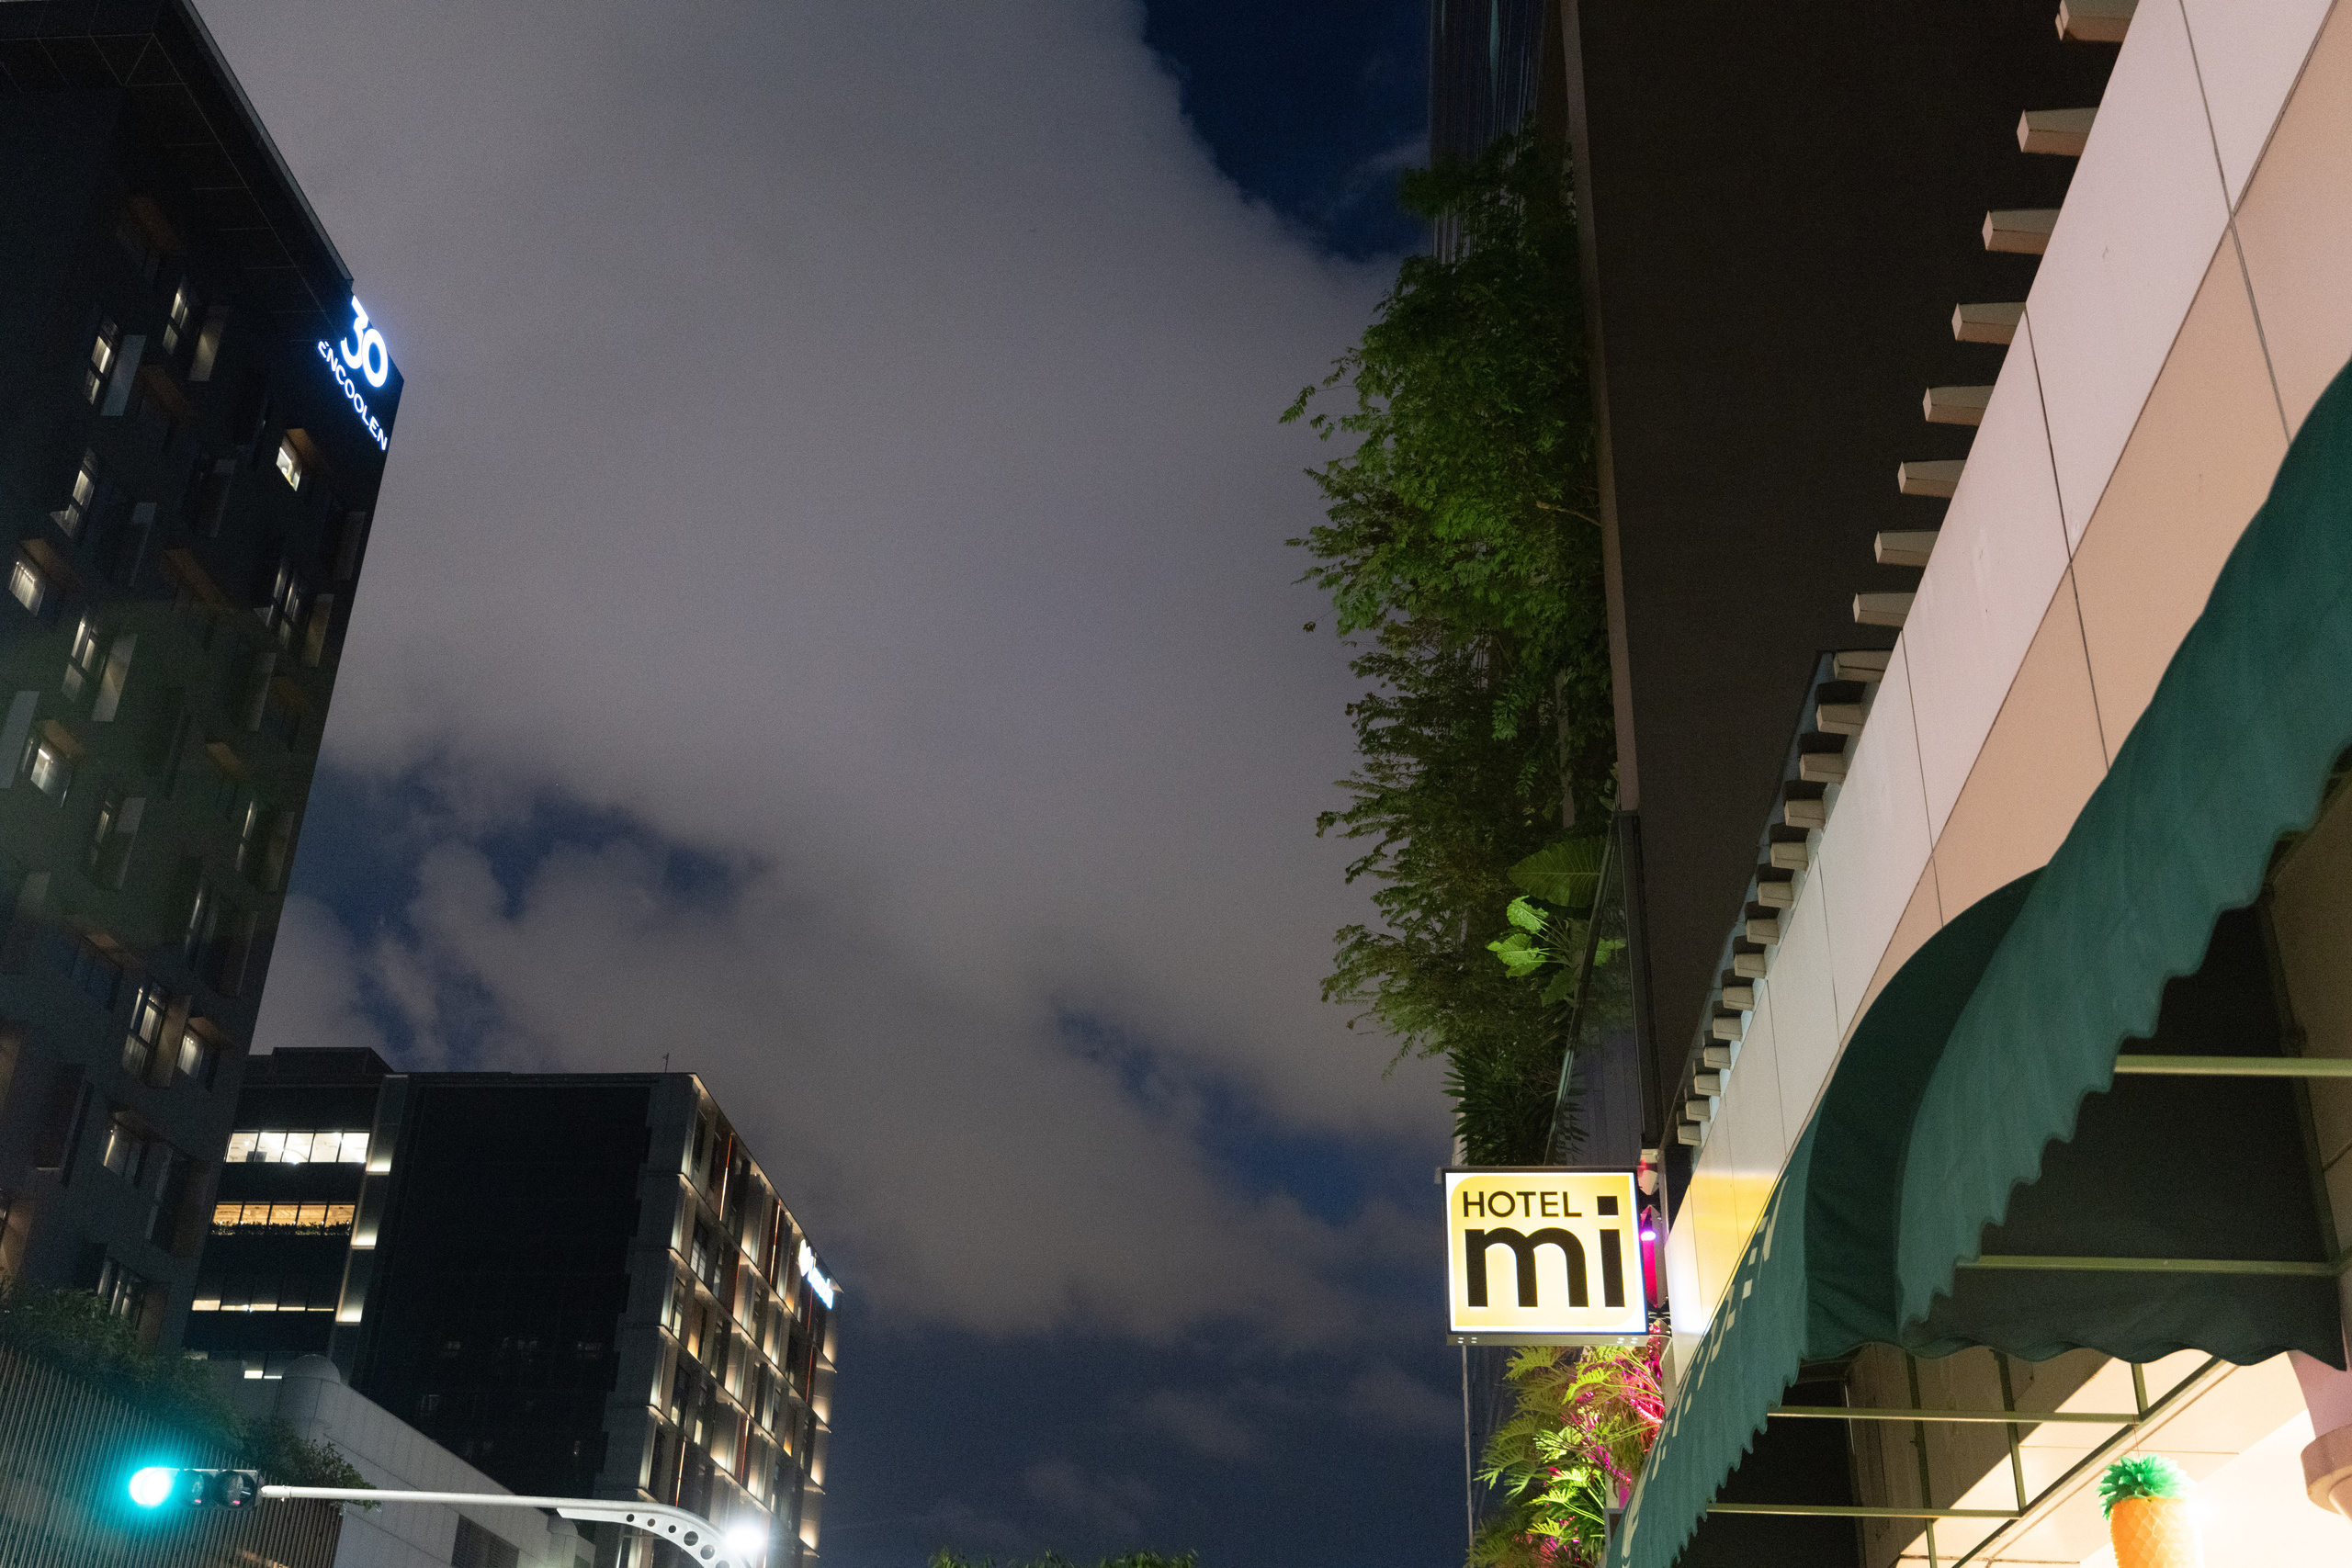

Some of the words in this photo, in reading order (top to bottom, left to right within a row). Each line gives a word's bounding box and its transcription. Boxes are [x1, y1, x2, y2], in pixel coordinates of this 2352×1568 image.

[340, 295, 389, 389] 30
[1463, 1190, 1582, 1218] HOTEL
[1464, 1195, 1625, 1308] mi
